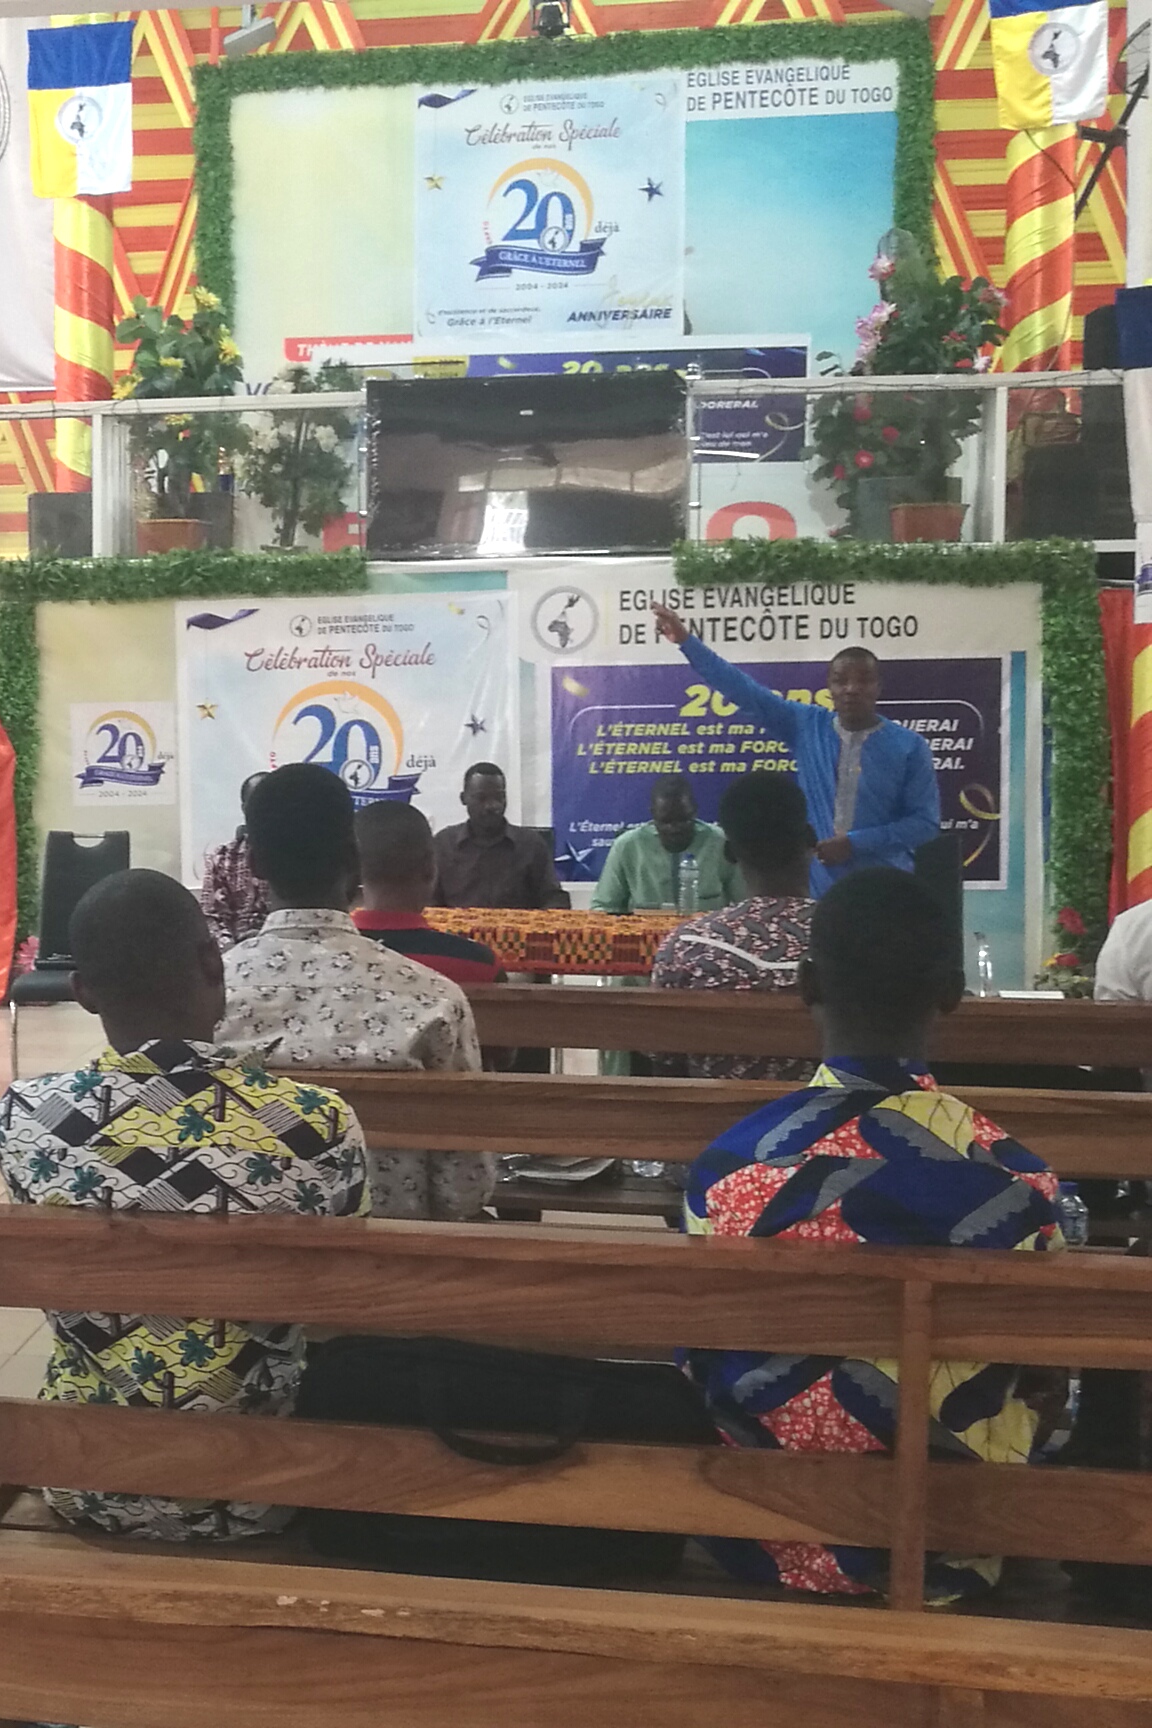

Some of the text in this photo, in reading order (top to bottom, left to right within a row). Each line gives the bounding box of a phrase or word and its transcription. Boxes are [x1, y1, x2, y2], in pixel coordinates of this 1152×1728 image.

[687, 65, 851, 88] EGLISE EVANGELIQUE
[687, 84, 893, 112] DE PENTECÔTE DU TOGO
[502, 179, 576, 245] 20
[567, 308, 673, 323] ANNIVERSAIRE
[619, 583, 855, 611] EGLISE EVANGELIQUE
[329, 622, 380, 634] PENTECÔTE
[619, 609, 918, 645] DE NTECÔTE DU TOGO
[596, 721, 691, 737] L'ÉTERNEL
[696, 724, 724, 736] est
[728, 724, 755, 735] ma
[96, 723, 145, 764] 20
[292, 704, 383, 783] 20
[577, 740, 672, 756] L'ÉTERNEL
[677, 743, 705, 755] est
[708, 743, 735, 754] ma
[739, 740, 789, 753] FORC
[406, 754, 437, 772] déjà
[588, 758, 683, 774] L'ÉTERNEL
[688, 761, 715, 773] est
[720, 761, 746, 773] ma
[751, 759, 799, 772] FORC
[569, 819, 625, 833] L'Éternel
[955, 819, 979, 830] m'a
